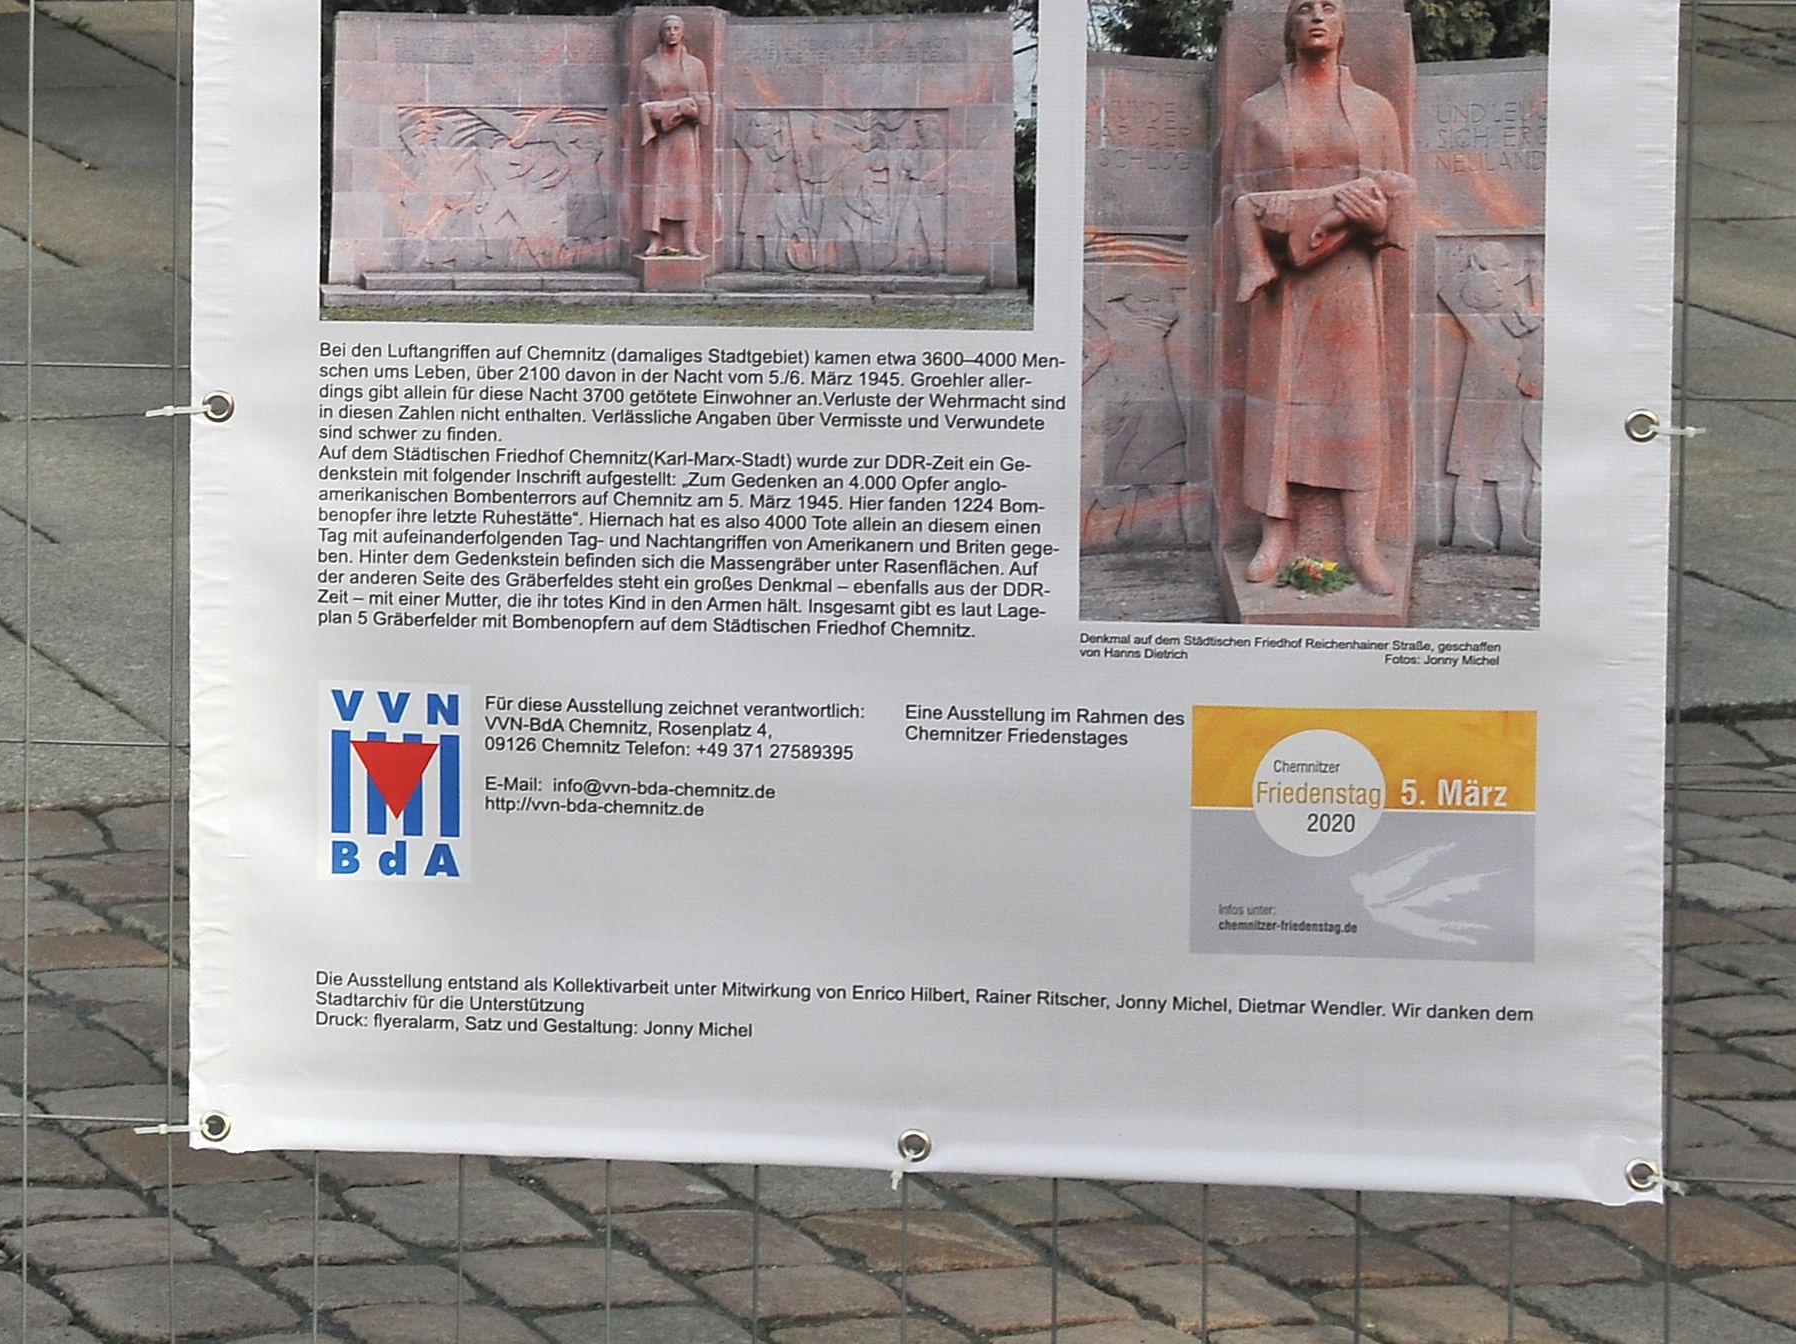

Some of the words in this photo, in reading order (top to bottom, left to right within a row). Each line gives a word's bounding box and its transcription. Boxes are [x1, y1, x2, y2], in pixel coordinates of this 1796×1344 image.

[1079, 632, 1130, 644] Denkmal
[1133, 634, 1152, 644] auf
[1154, 634, 1180, 645] dem
[1183, 635, 1251, 647] Städtischen
[1254, 636, 1302, 648] Friedhof
[1304, 637, 1389, 650] Reichenhainer
[1391, 639, 1434, 652] Straße,
[1437, 641, 1501, 653] geschaffen
[1079, 649, 1100, 657] von
[1103, 646, 1141, 658] Hanns
[1144, 647, 1188, 659] Dietrich
[1384, 653, 1420, 664] Fotos:
[1423, 654, 1459, 667] Jonny
[1461, 654, 1499, 665] Michel
[905, 703, 942, 720] Eine
[946, 704, 1045, 726] Ausstellung
[1050, 707, 1070, 723] im
[1076, 707, 1148, 724] Rahmen
[1154, 711, 1186, 727] des
[484, 715, 564, 732] VVN-BdA
[568, 717, 652, 737] Chemnitz,
[658, 720, 752, 739] Rosenplatz
[756, 722, 771, 739] 4,
[905, 725, 1002, 742] Chemnitzer
[1007, 727, 1128, 748] Friedenstages
[484, 735, 536, 751] 09126
[541, 737, 620, 754] Chemnitz
[624, 739, 690, 756] Telefon:
[696, 742, 727, 757] +49
[732, 742, 762, 758] 371
[769, 743, 853, 760] 27589395
[1273, 760, 1340, 774] Chemnitzer
[485, 775, 542, 791] E-Mail:
[553, 777, 775, 798] info@vvn-bda-chemnitz.de
[1257, 781, 1381, 808] Friedenstag
[1400, 778, 1426, 806] 5.
[1437, 778, 1508, 807] März
[485, 795, 704, 816] http://vvn-bda-chemnitz.de
[1307, 813, 1356, 833] 2020
[331, 840, 460, 877] BdA
[1218, 904, 1245, 916] Infos
[1247, 905, 1276, 916] unter:
[1218, 919, 1358, 935] chemnitzer-friedenstag.de
